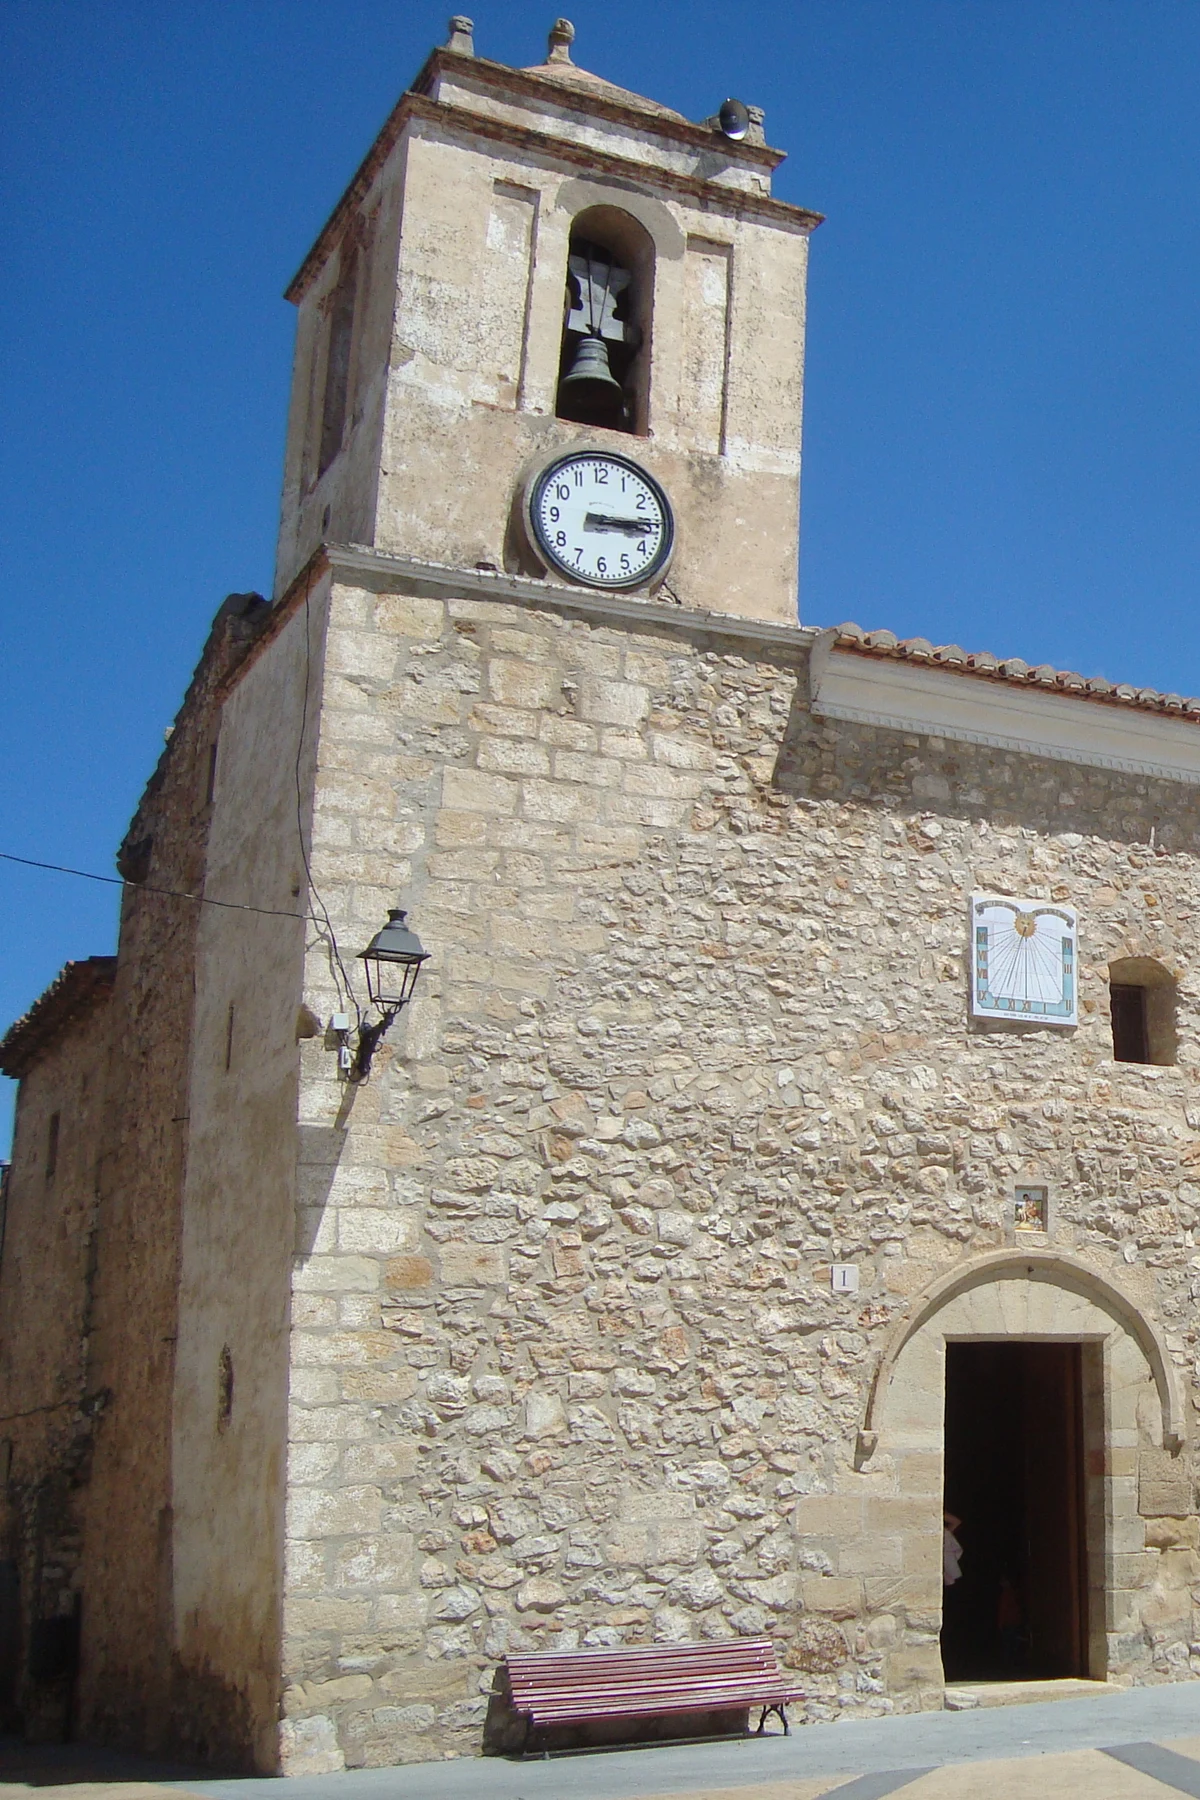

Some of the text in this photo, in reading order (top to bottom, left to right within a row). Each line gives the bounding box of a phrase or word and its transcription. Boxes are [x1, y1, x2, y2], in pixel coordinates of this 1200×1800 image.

[574, 471, 583, 487] 11
[594, 467, 609, 485] 12
[621, 476, 626, 493] 1
[556, 484, 570, 500] 10
[636, 493, 646, 510] 2
[550, 506, 560, 522] 9
[556, 530, 567, 547] 8
[574, 548, 584, 565] 7
[636, 540, 647, 556] 4
[596, 556, 607, 573] 6
[620, 553, 630, 570] 5
[1065, 999, 1072, 1011] II
